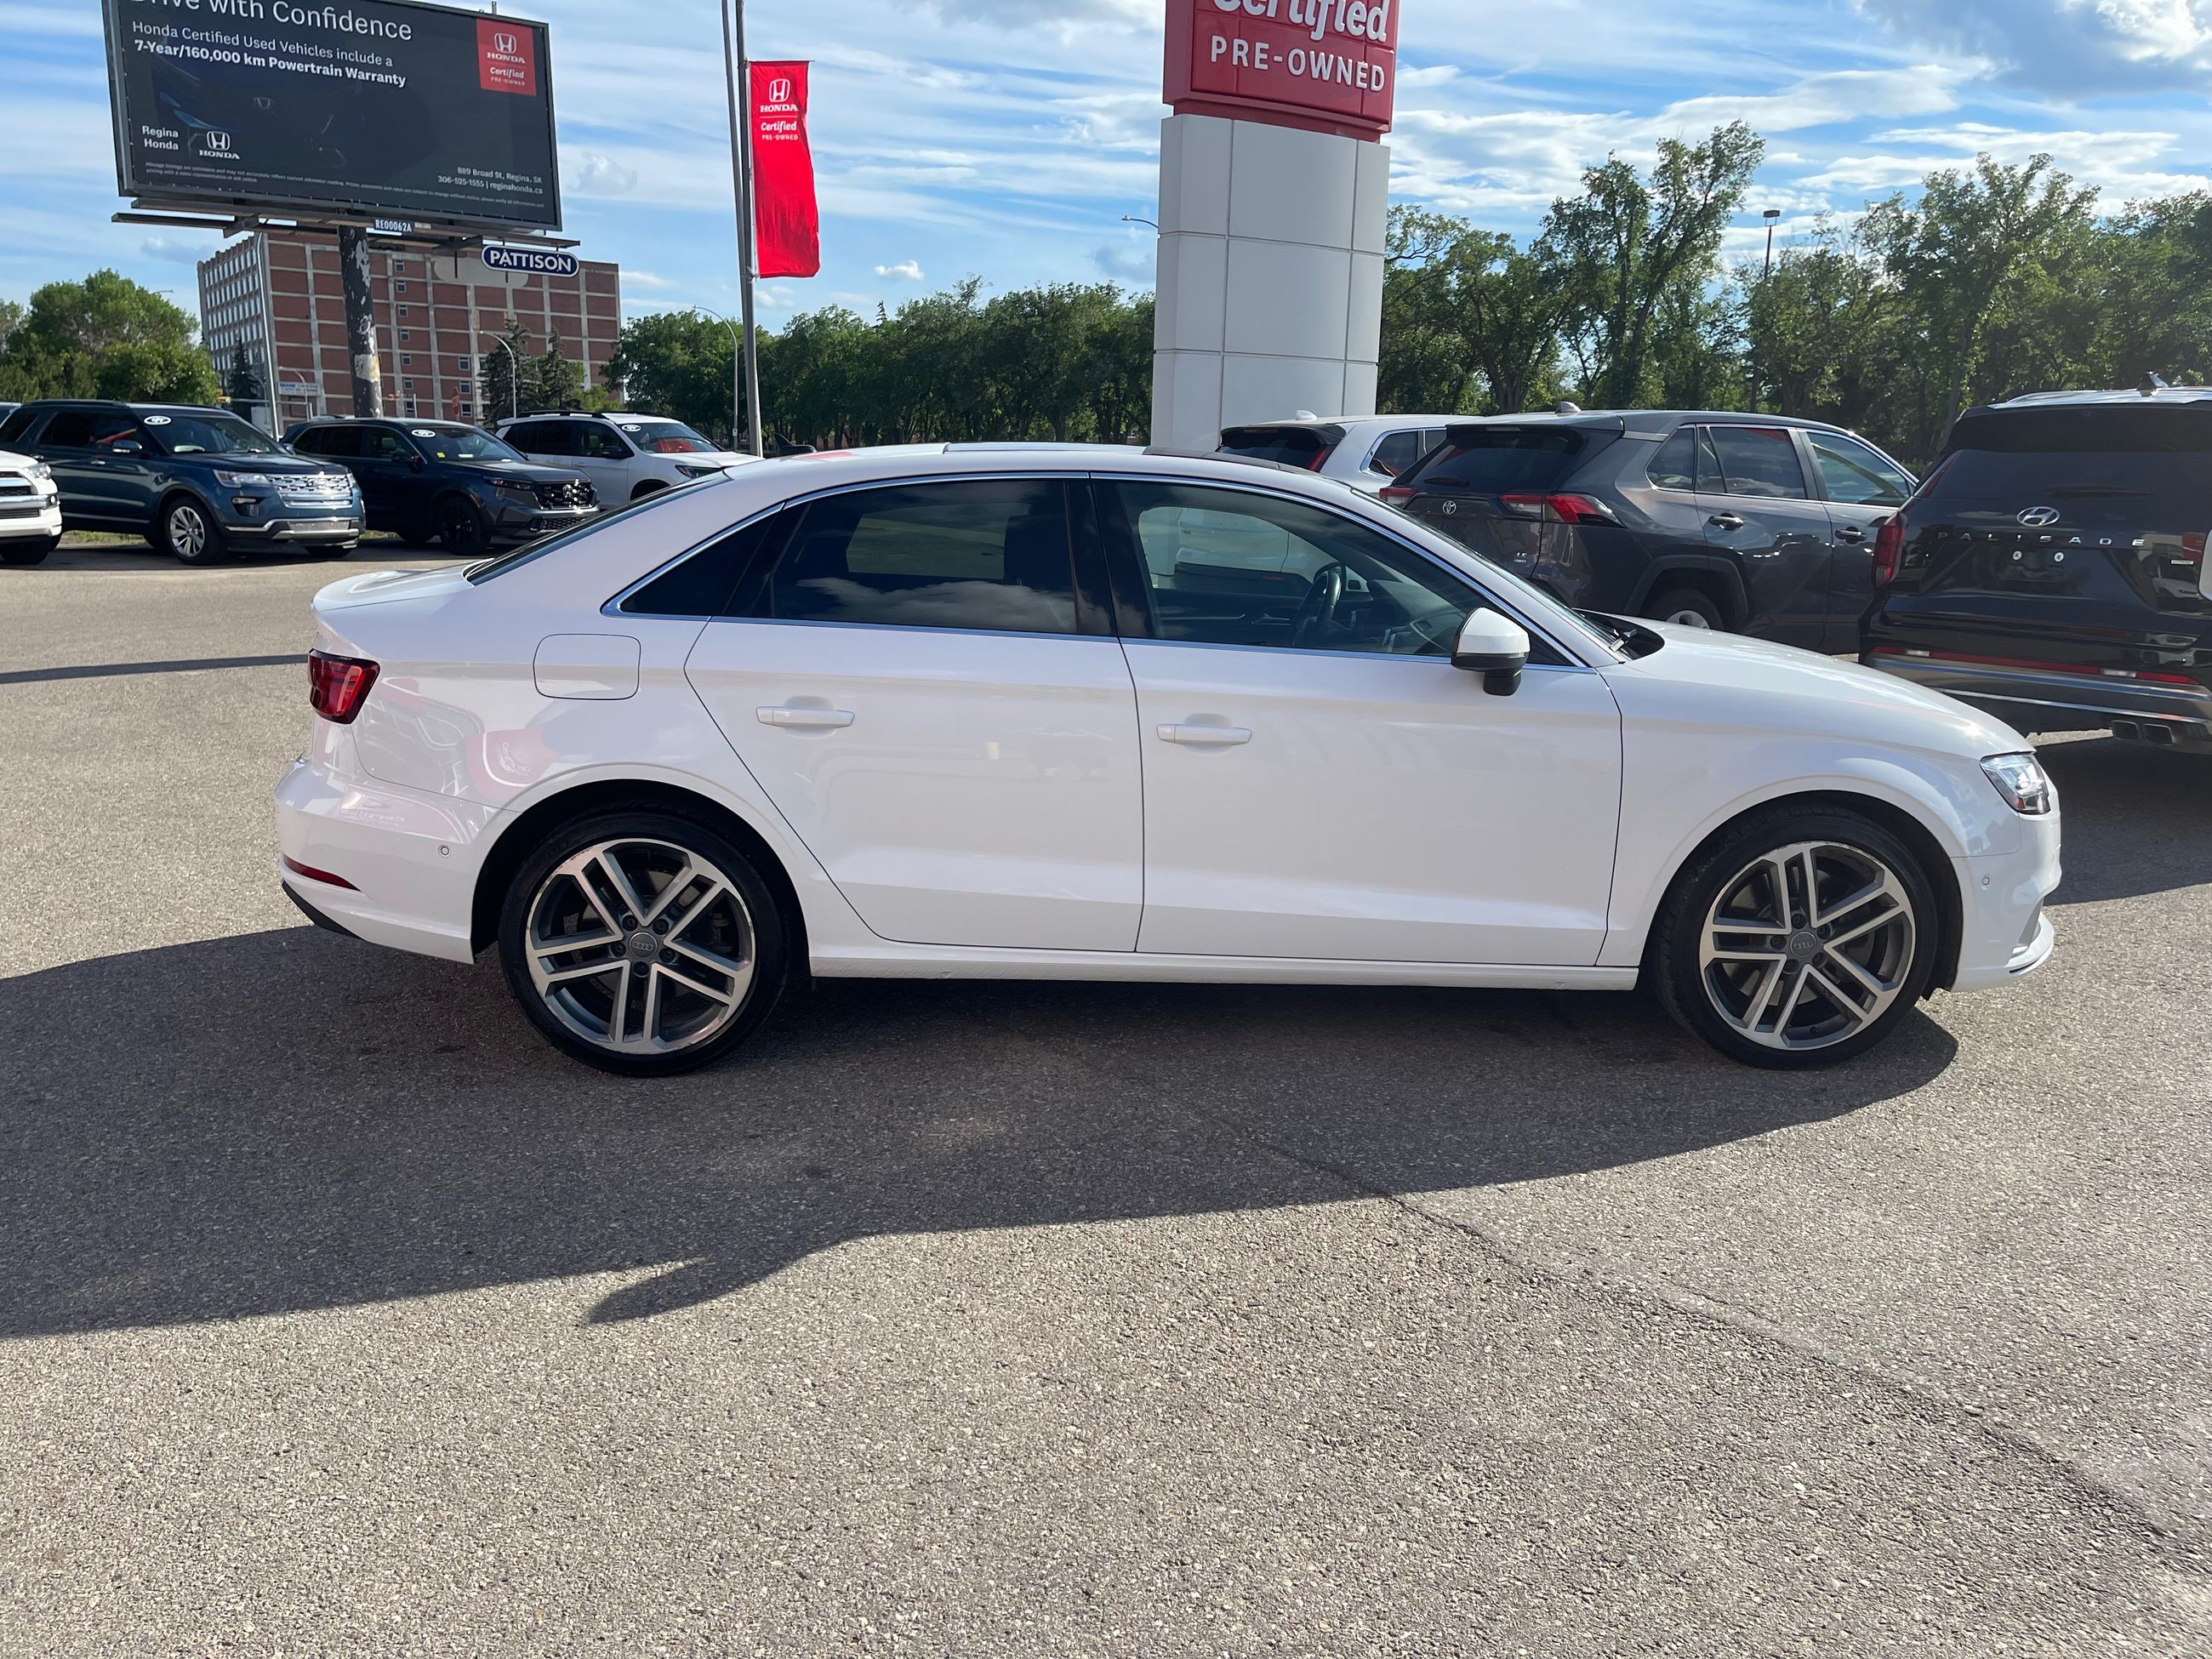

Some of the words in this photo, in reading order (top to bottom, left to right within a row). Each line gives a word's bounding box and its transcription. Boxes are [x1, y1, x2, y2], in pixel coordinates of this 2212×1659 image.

[210, 0, 265, 19] with
[272, 0, 412, 40] Confidence
[132, 20, 179, 38] Honda
[181, 27, 240, 46] Certified
[243, 36, 276, 51] Used
[279, 40, 334, 59] Vehicles
[336, 48, 383, 65] include
[385, 57, 393, 66] a
[134, 39, 241, 64] 7-Year/160,000
[243, 53, 266, 67] km
[269, 57, 343, 77] Powertrain
[345, 66, 407, 88] Warranty
[487, 52, 526, 64] HONDA
[1211, 35, 1385, 92] PRE-OWNED
[489, 66, 525, 78] Certified
[760, 104, 798, 112] HONDA
[142, 125, 179, 138] Regina
[761, 121, 797, 134] Certified
[144, 138, 179, 151] Honda
[198, 150, 240, 160] HONDA
[472, 168, 493, 178] Broad
[506, 173, 533, 184] Regina,
[490, 182, 544, 195] reginahonda.ca
[489, 250, 572, 273] PATTISON
[1937, 532, 2146, 547] PALISADE
